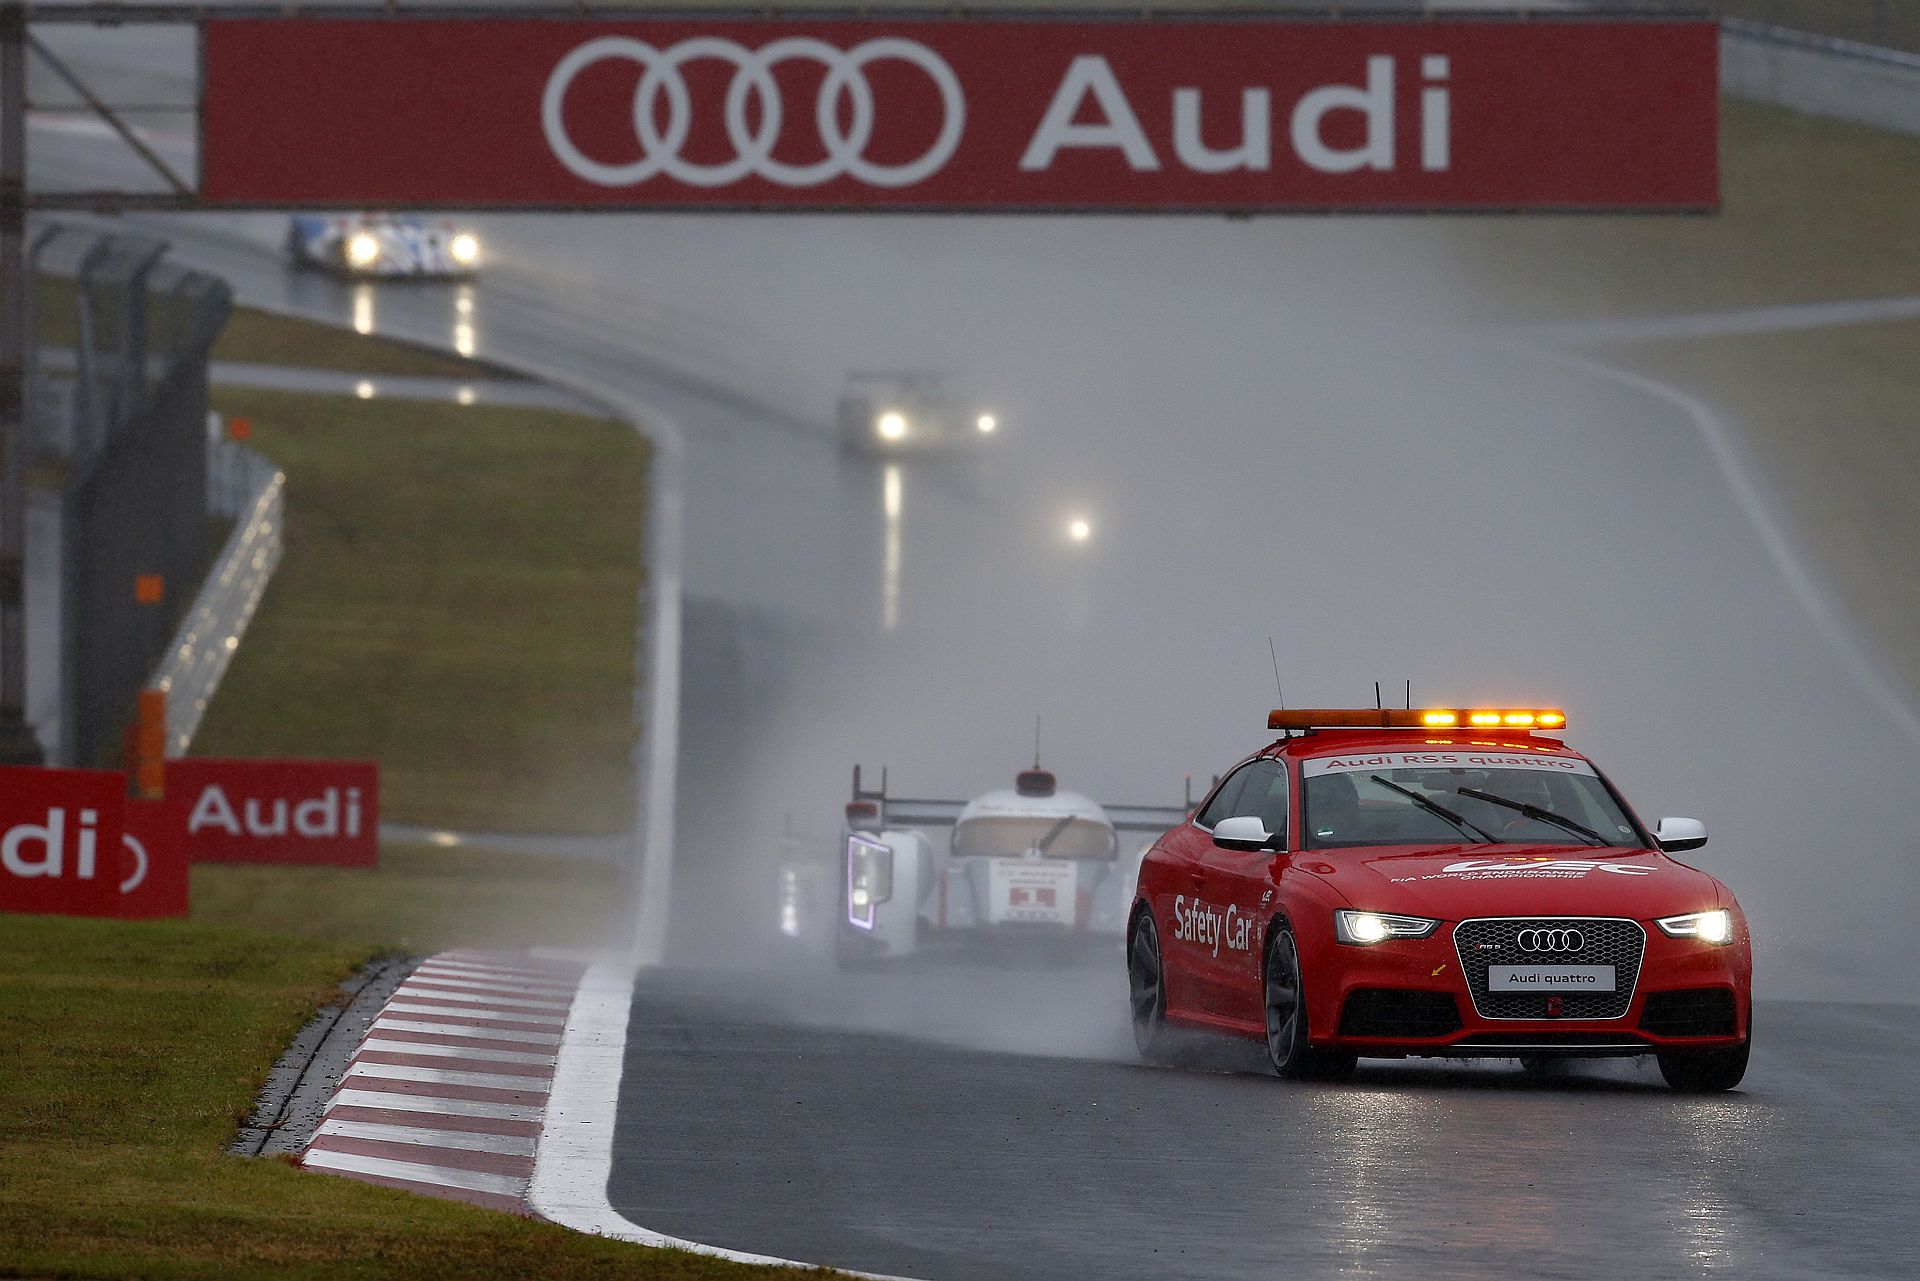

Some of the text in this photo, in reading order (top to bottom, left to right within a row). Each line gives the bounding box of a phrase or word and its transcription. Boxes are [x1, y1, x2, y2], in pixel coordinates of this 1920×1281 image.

[1018, 54, 1450, 173] Audi
[1326, 755, 1576, 769] Audi RS5 quattro
[188, 784, 362, 838] Audi
[1421, 872, 1479, 880] WORLD
[1175, 894, 1252, 958] Safety Car
[1509, 973, 1596, 985] Audi quattro
